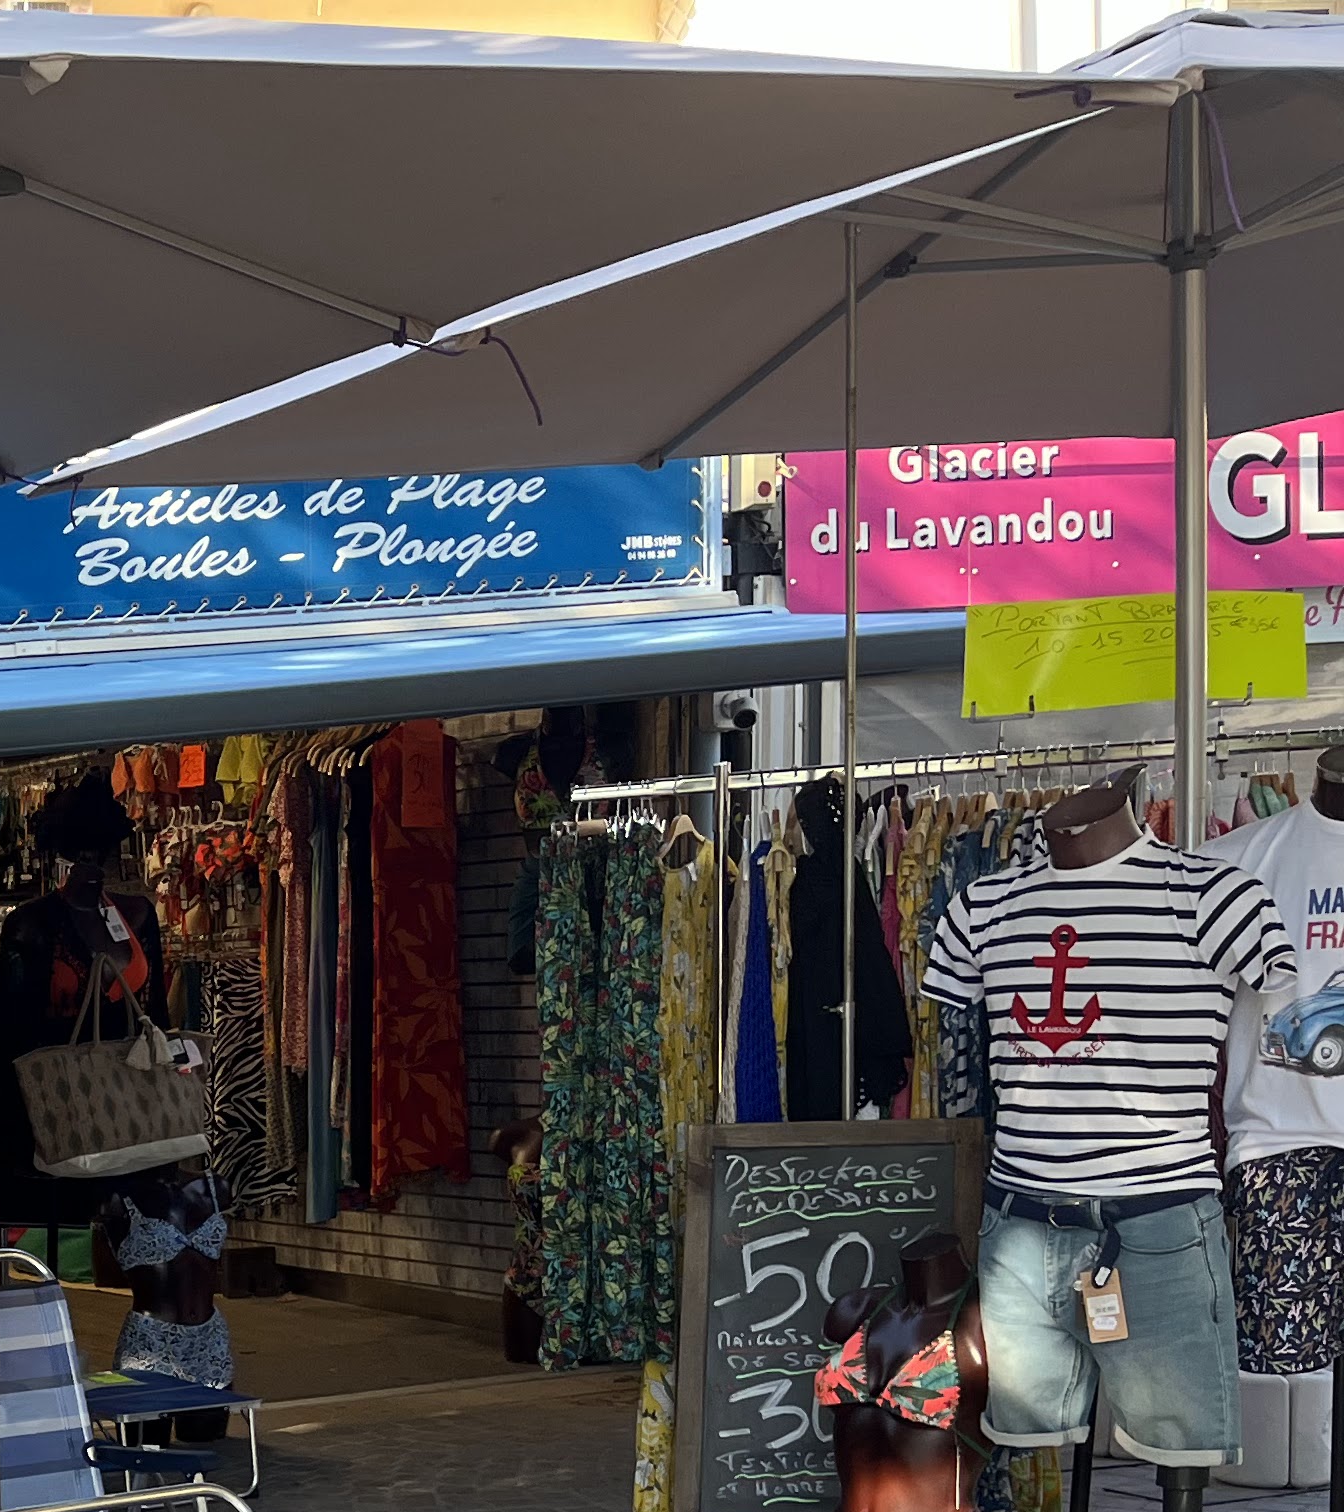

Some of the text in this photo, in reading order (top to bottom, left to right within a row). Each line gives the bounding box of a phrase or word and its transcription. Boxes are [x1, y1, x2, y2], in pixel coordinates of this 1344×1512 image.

[888, 441, 1060, 484] Glacier
[62, 473, 547, 535] Articles de Plage
[811, 497, 1113, 554] du Lavandou
[74, 535, 258, 587] Boules
[331, 520, 539, 578] Plongée
